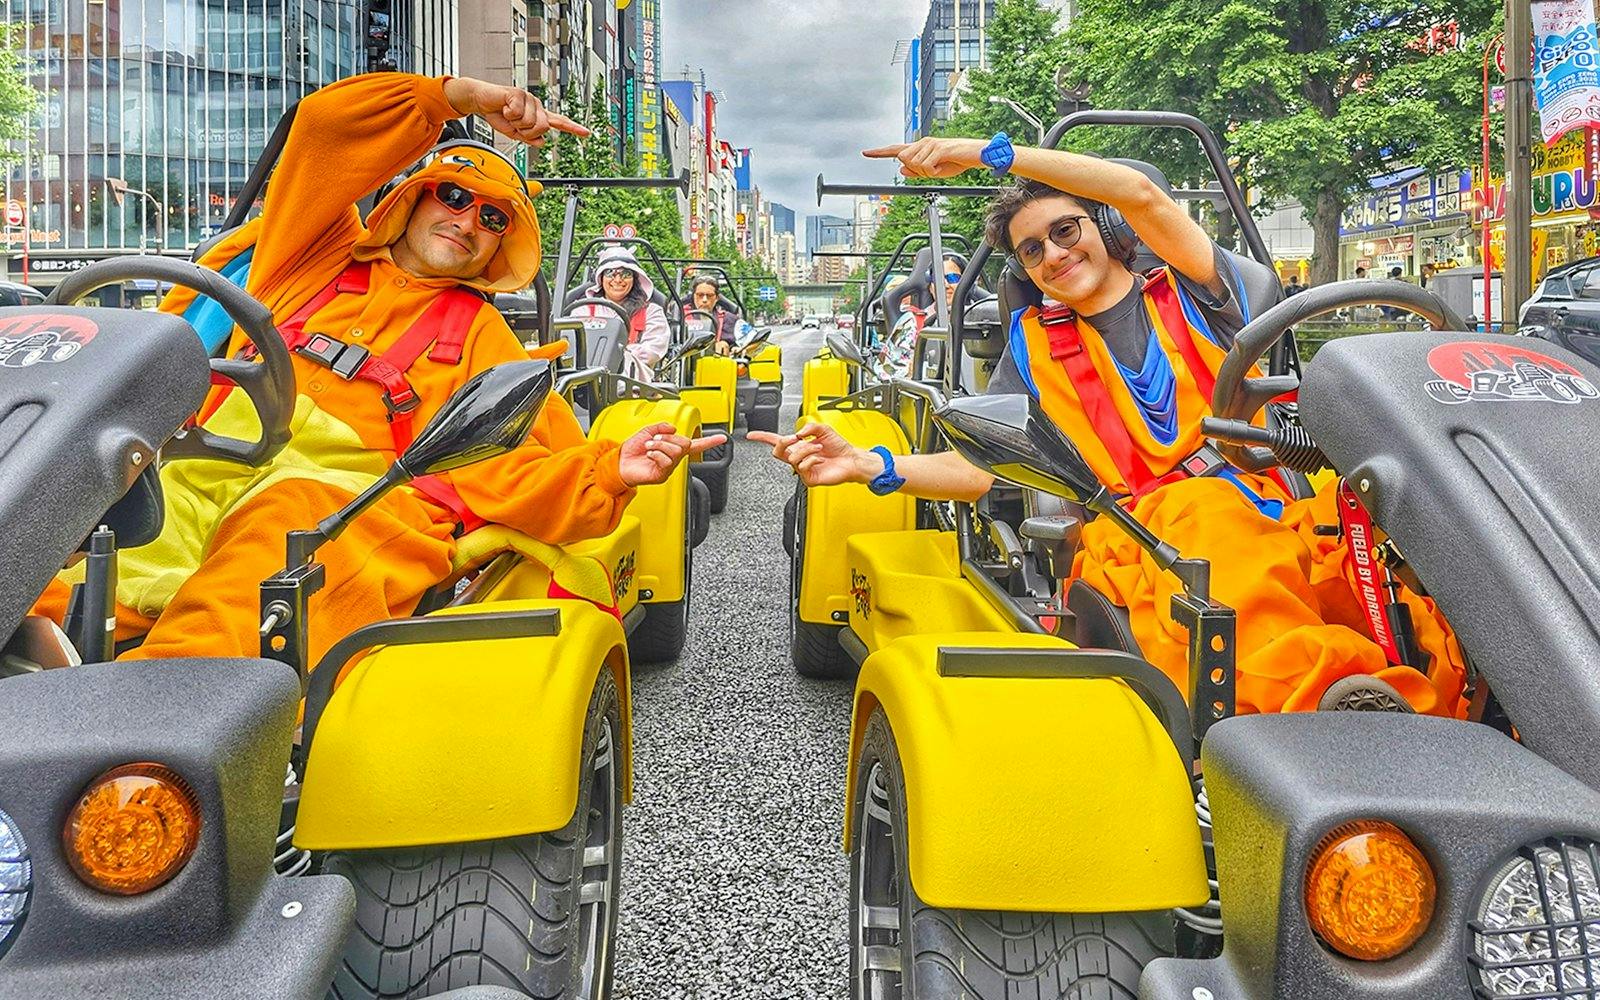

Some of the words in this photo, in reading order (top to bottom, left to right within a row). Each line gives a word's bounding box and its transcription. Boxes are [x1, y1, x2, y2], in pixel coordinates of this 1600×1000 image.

[1547, 153, 1575, 169] HOBBY
[0, 231, 26, 245] oyal
[30, 229, 61, 242] Host
[1350, 523, 1369, 566] FUELED
[1358, 567, 1373, 585] BY
